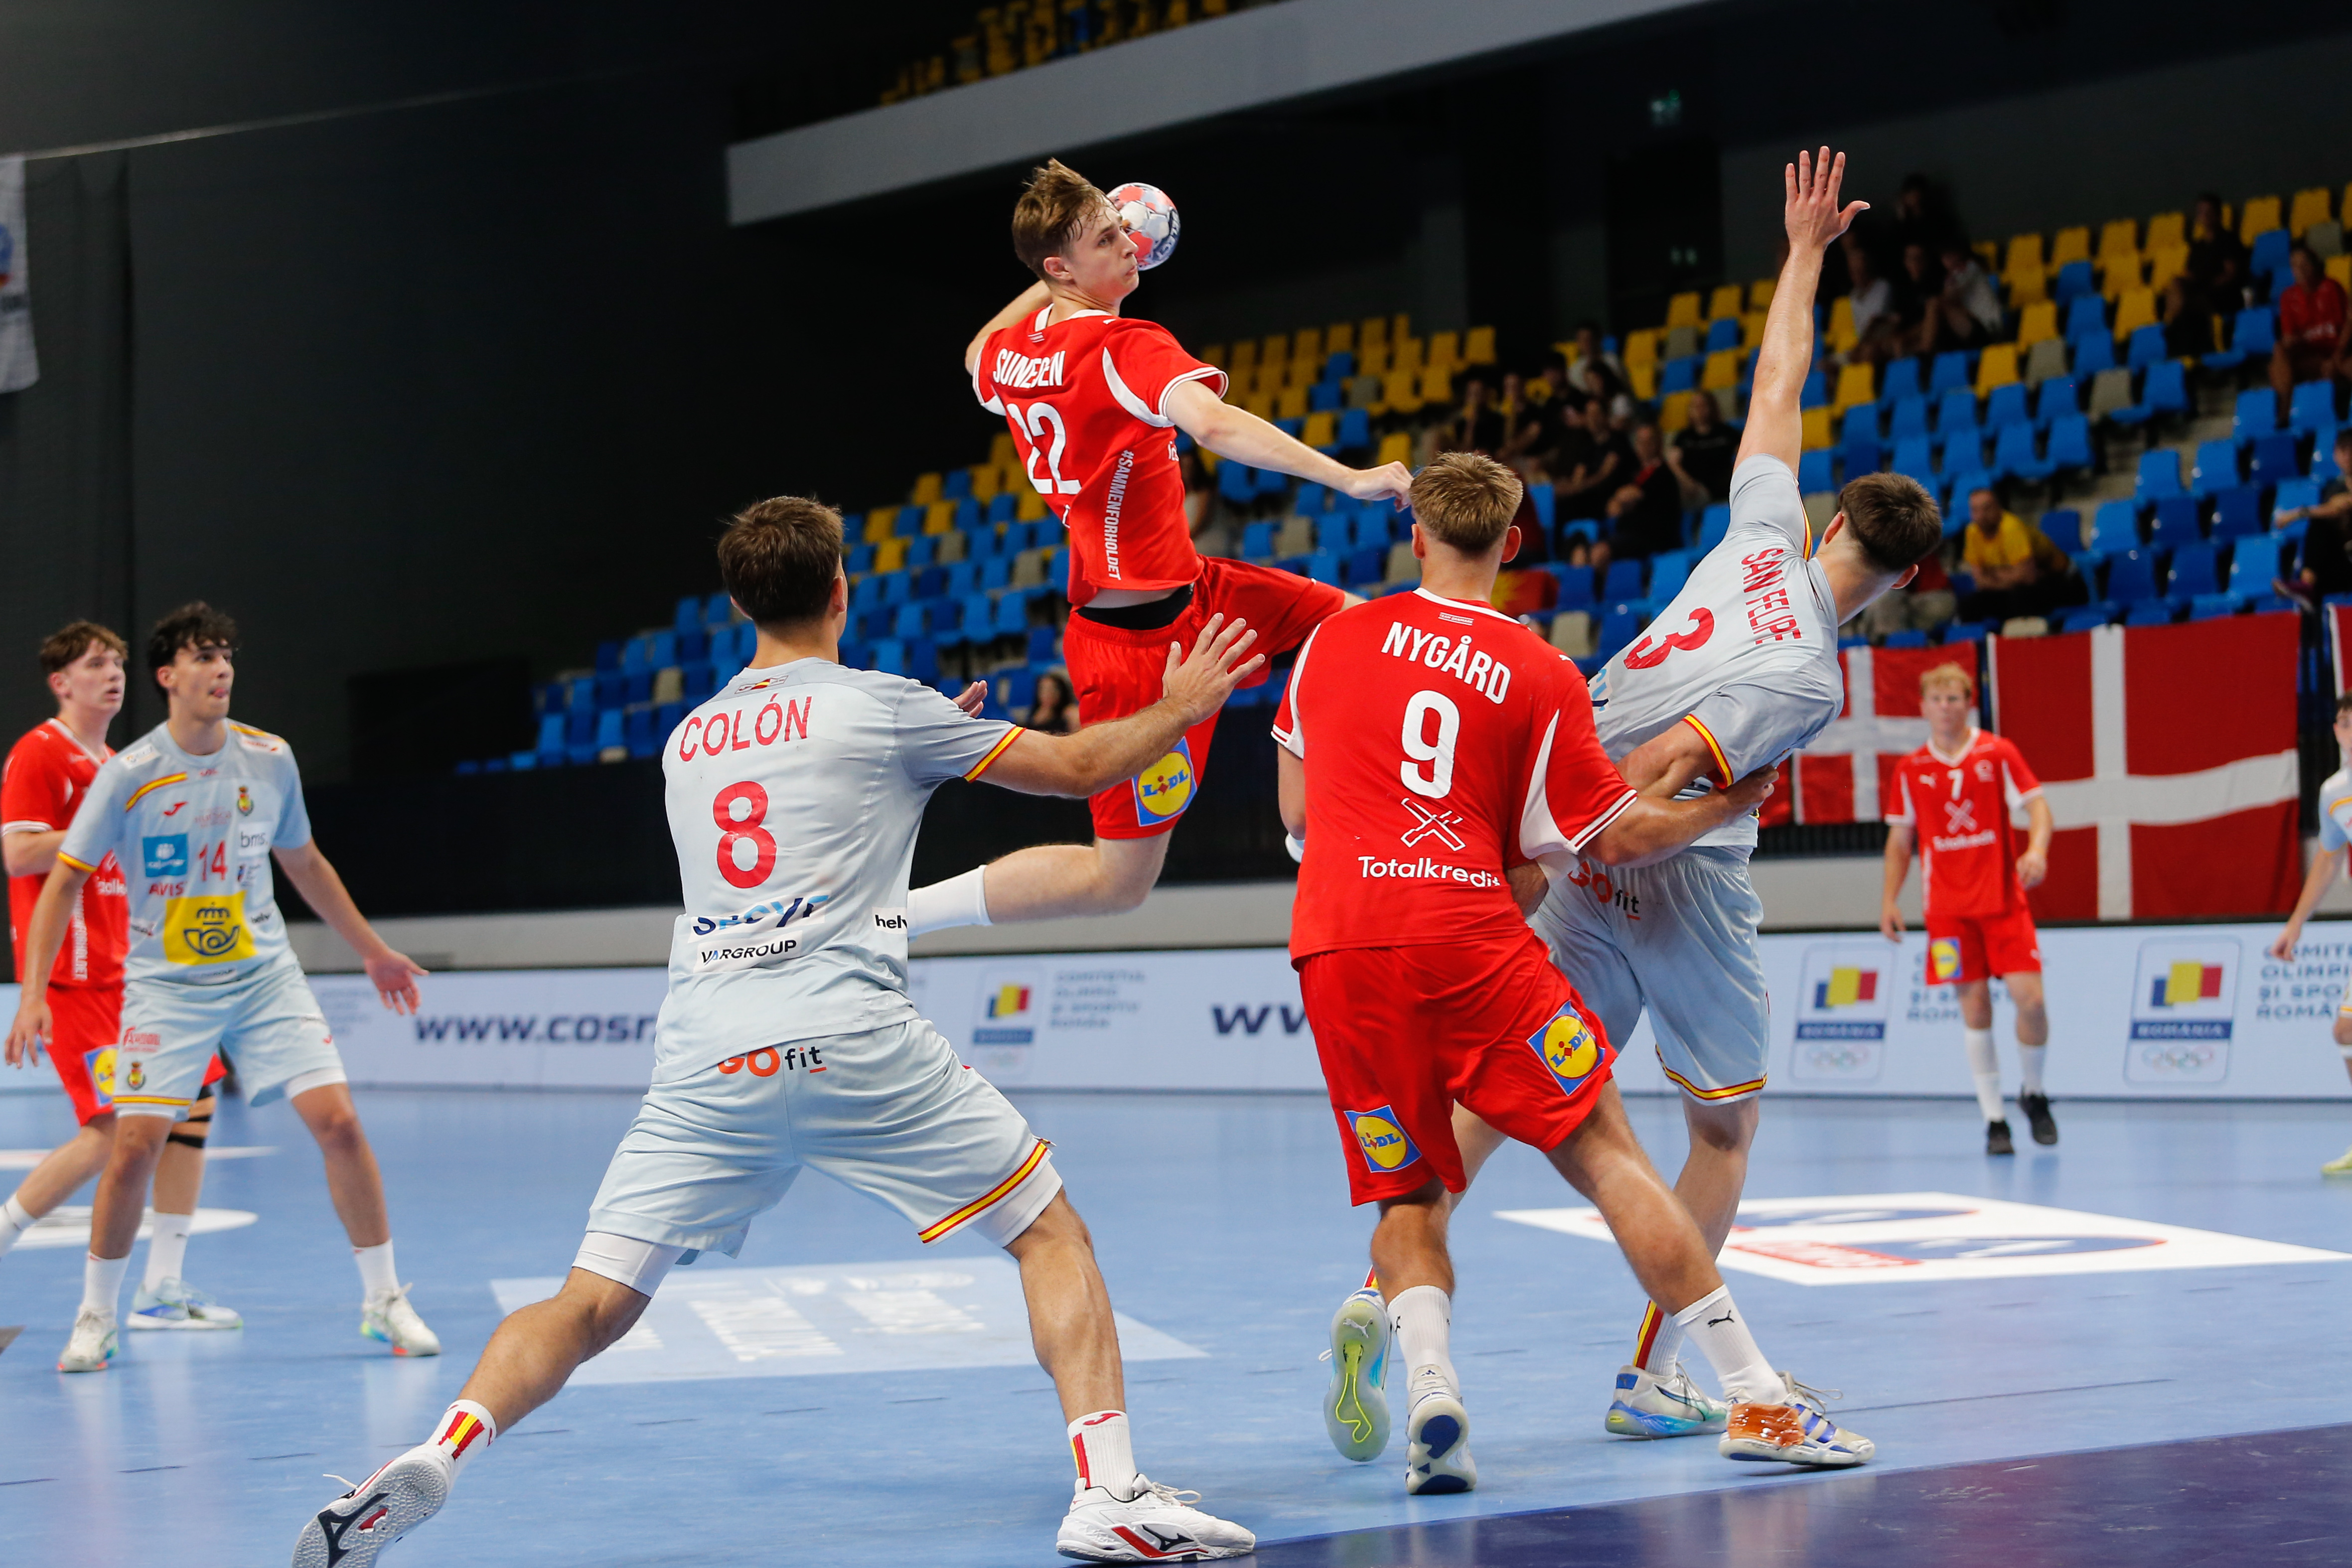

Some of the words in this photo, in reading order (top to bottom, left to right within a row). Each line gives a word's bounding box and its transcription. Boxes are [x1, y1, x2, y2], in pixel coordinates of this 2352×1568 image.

[1006, 402, 1082, 494] 22
[1104, 449, 1135, 580] #SAMMENFORHOLDET
[1741, 549, 1784, 593] SAN
[1623, 607, 1715, 670] 3
[1746, 587, 1802, 645] FELIPE
[1381, 621, 1512, 705] NYGÅRD
[679, 693, 813, 762] COLÓN
[1400, 690, 1460, 799] 9
[1947, 768, 1964, 800] 7
[199, 840, 228, 882] 14
[713, 780, 777, 889] 8
[148, 881, 184, 896] AVIS
[1357, 855, 1501, 888] Totalkredit
[1616, 888, 1640, 914] fit
[785, 1046, 823, 1070] fit
